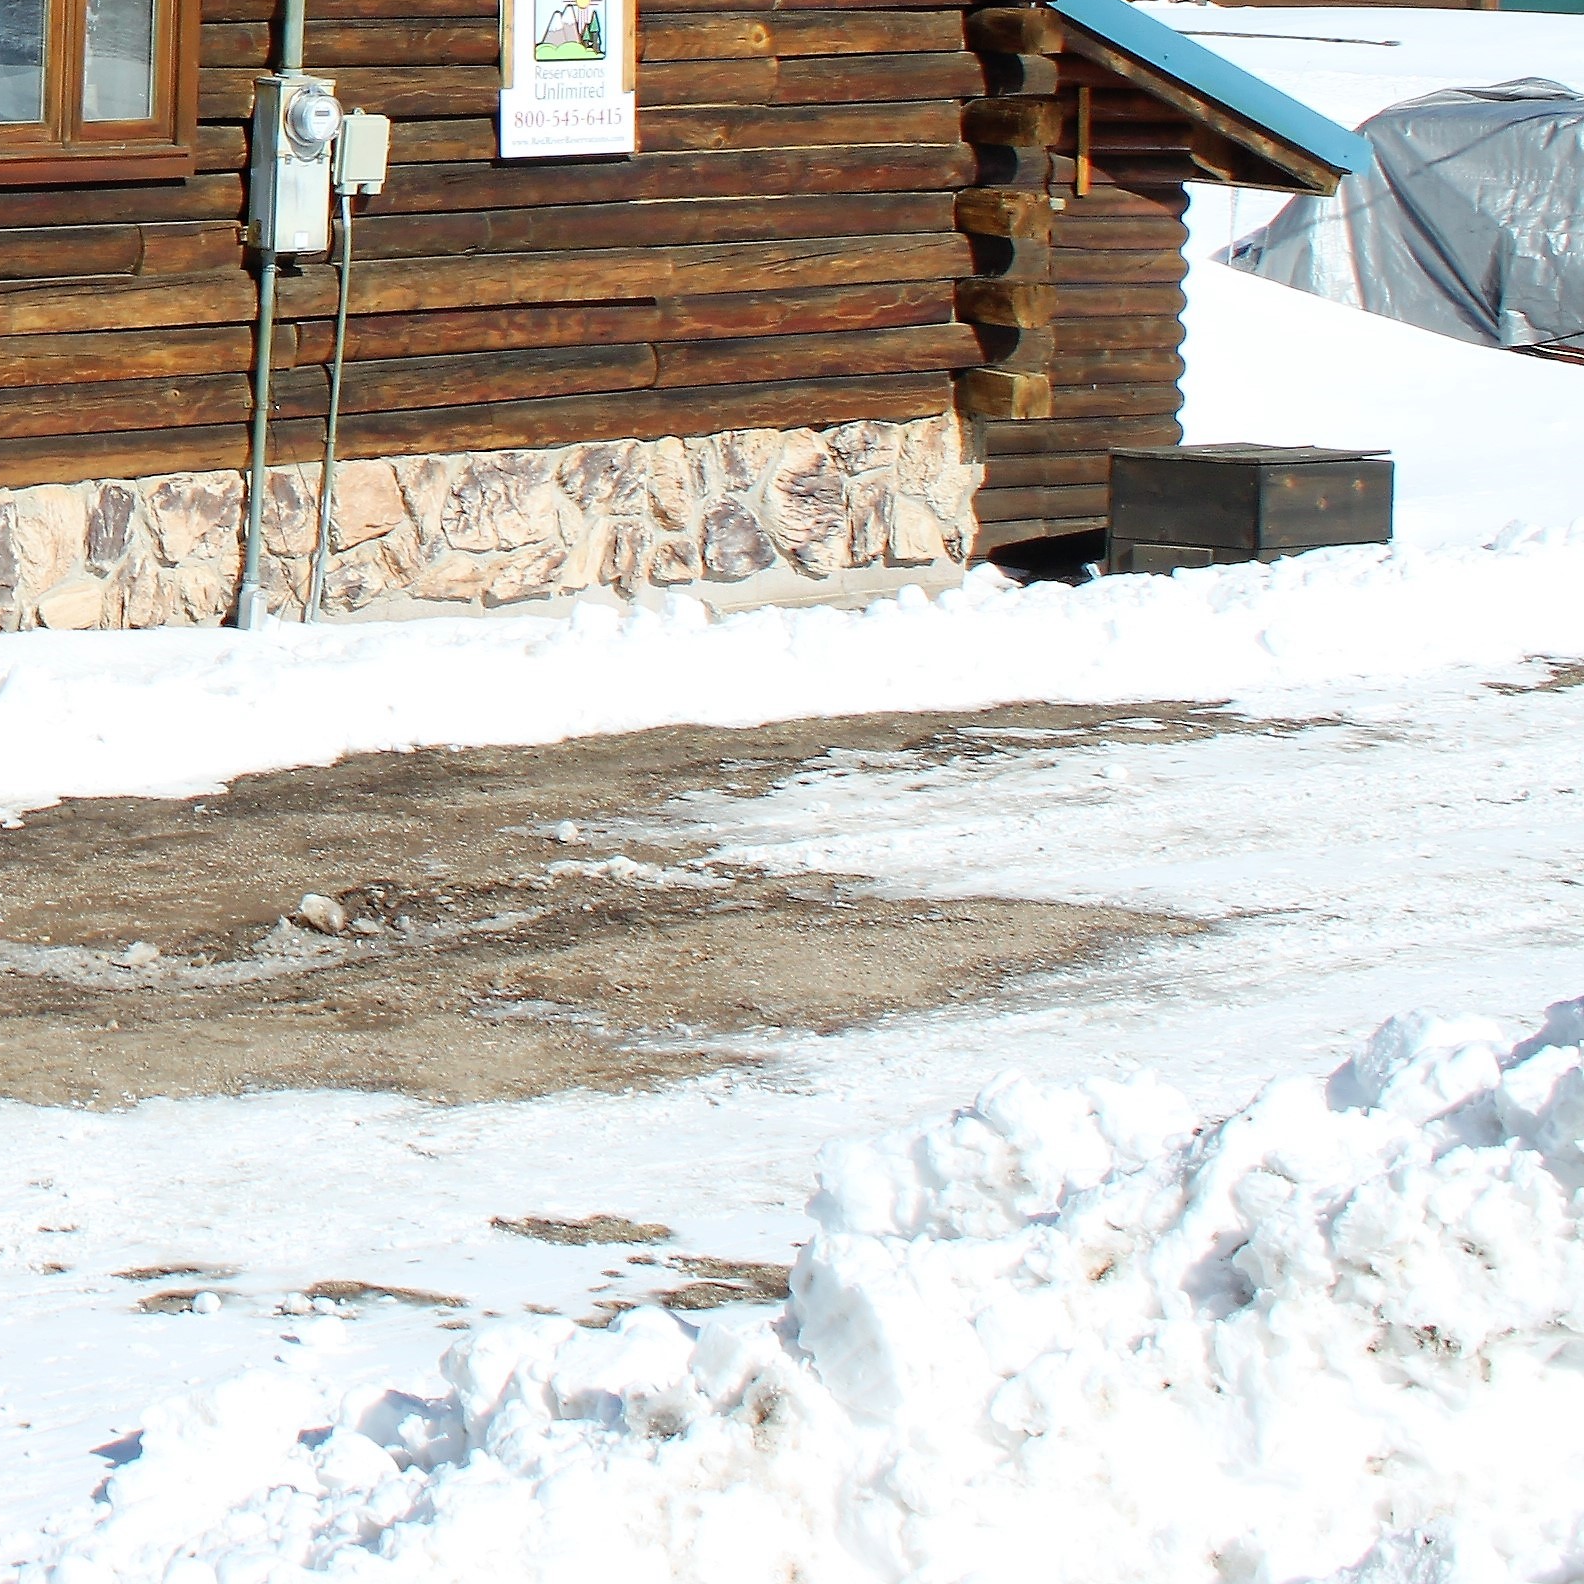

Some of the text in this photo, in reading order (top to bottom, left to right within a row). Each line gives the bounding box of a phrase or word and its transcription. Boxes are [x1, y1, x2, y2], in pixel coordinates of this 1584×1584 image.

[534, 65, 605, 80] Reservations
[534, 81, 605, 100] Unlimited
[514, 107, 622, 128] 800-545-6415
